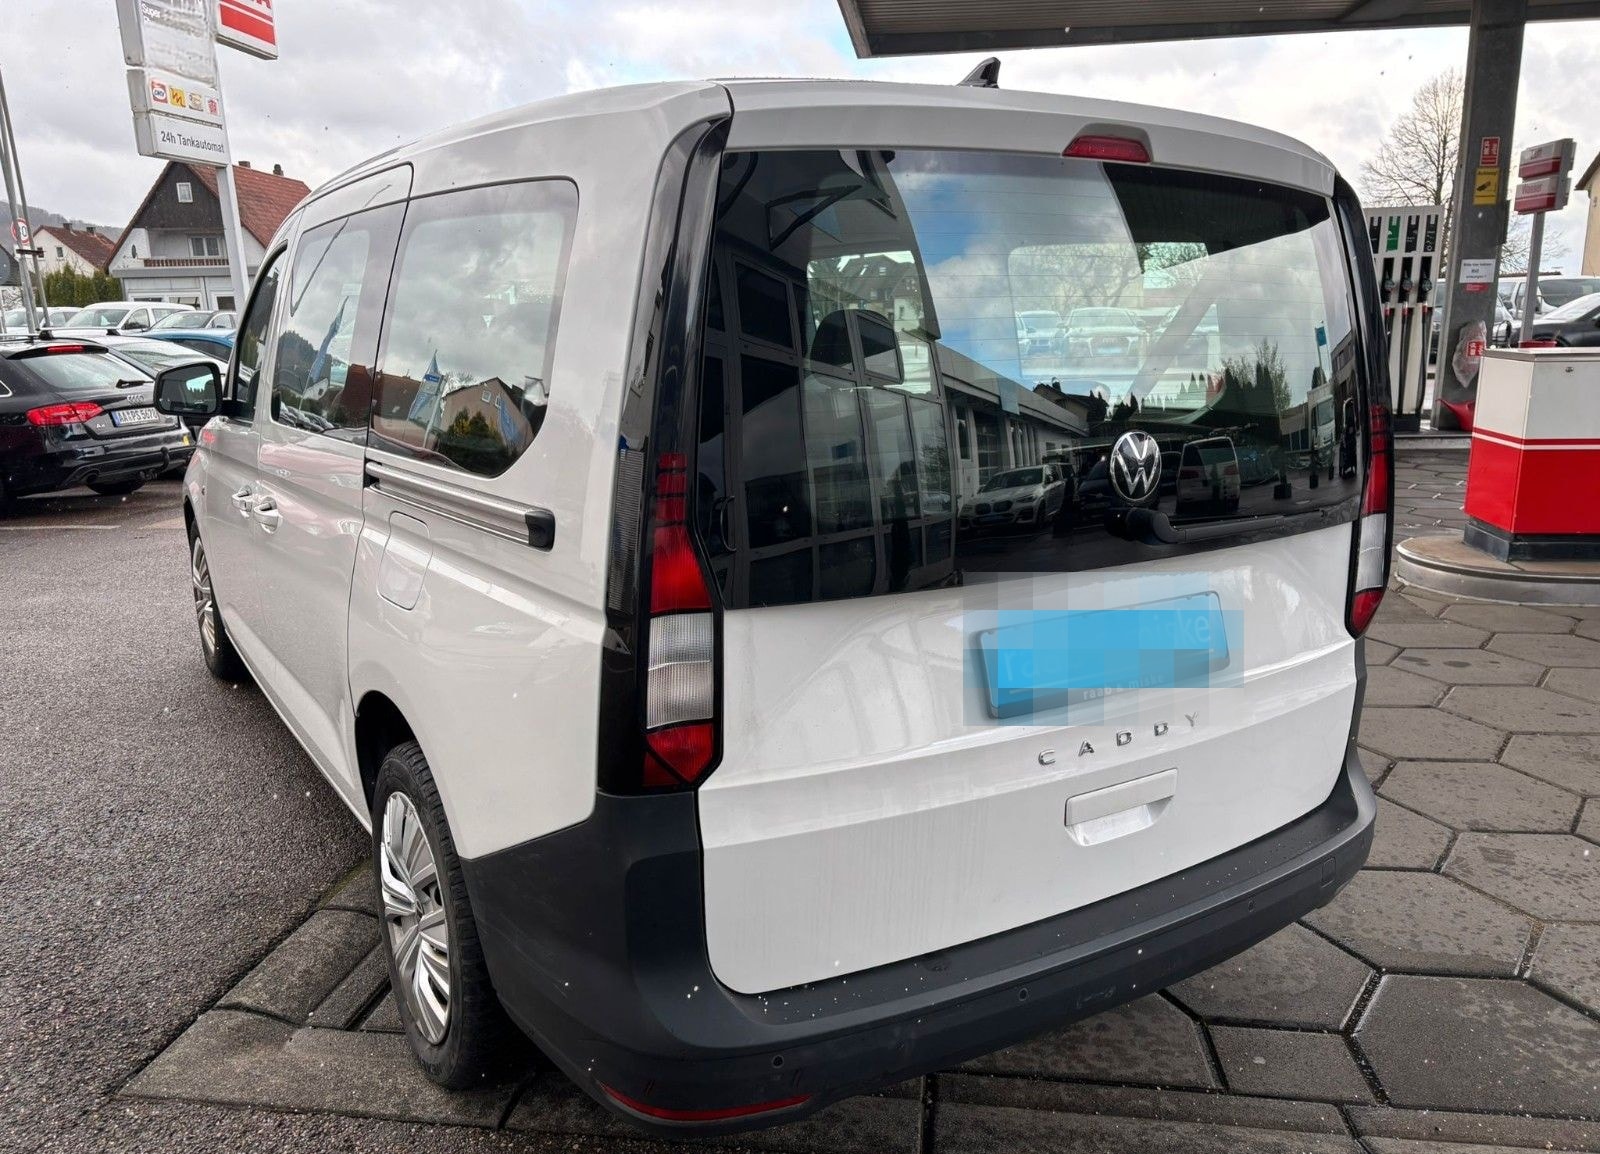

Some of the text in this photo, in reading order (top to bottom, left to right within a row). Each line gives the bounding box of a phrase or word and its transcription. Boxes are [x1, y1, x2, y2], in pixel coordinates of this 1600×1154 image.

[160, 131, 225, 153] 24h Tankautomat
[1038, 711, 1198, 766] CADDY
